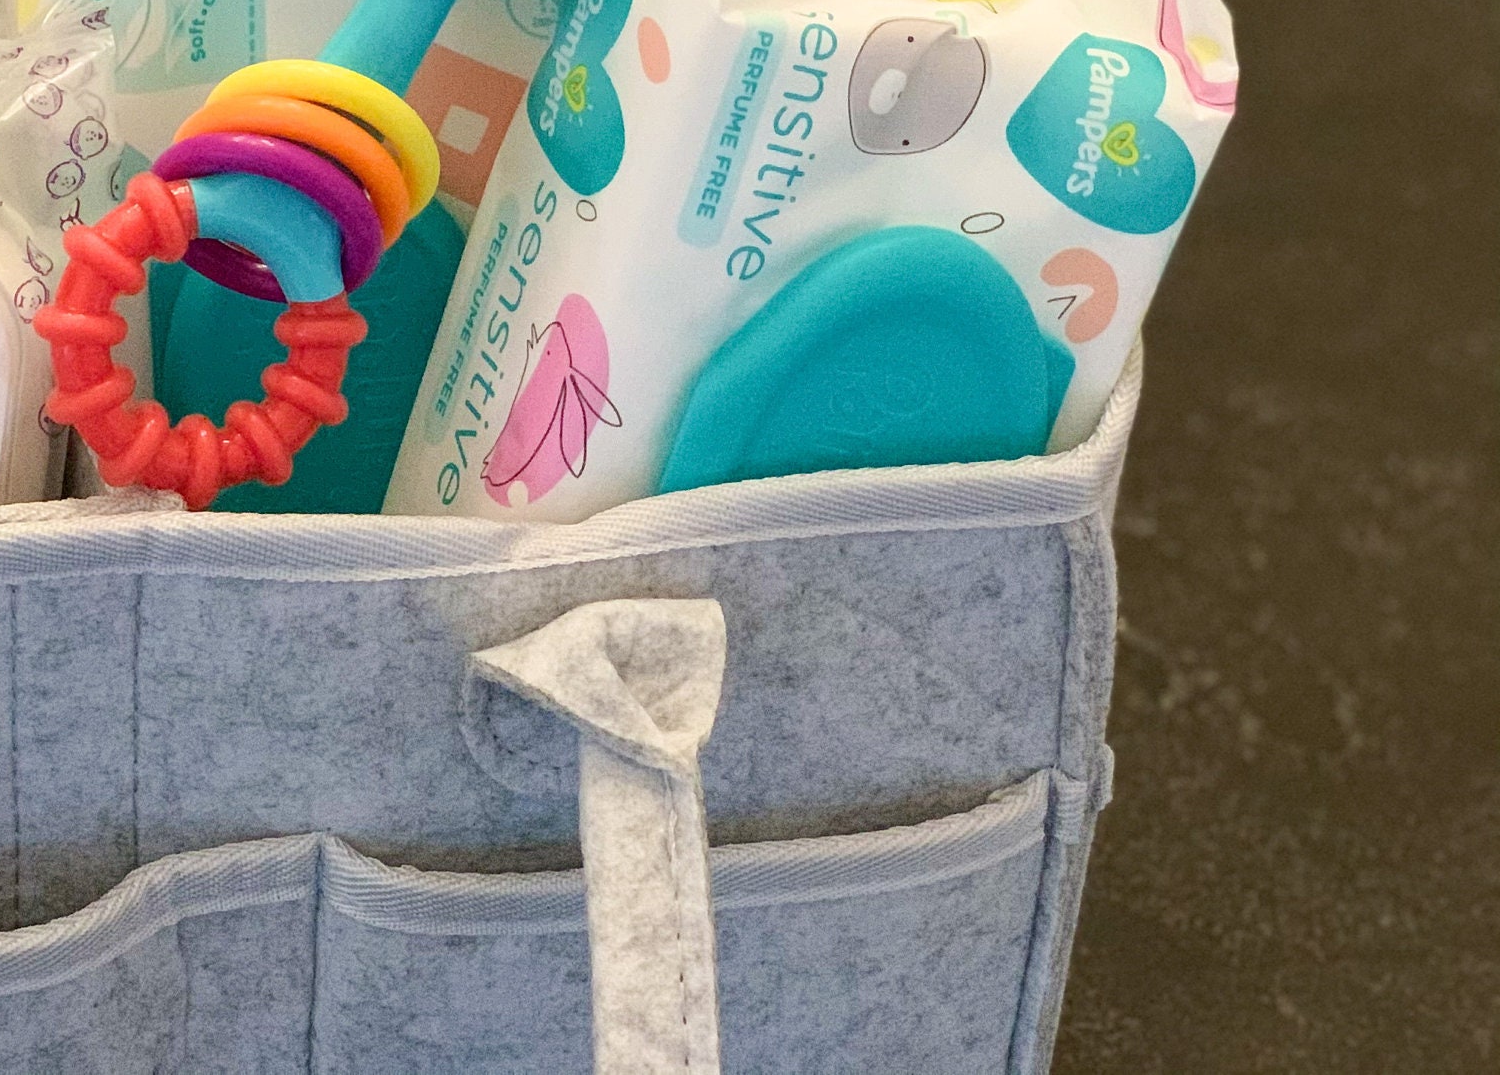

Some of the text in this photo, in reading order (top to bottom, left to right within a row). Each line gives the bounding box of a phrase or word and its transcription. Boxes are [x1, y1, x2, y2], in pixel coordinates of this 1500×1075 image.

[696, 29, 774, 220] PERFUME FREE
[726, 12, 838, 281] ensitive
[1066, 47, 1131, 198] Pampers
[435, 221, 509, 417] PERFUME FREE
[437, 180, 558, 507] sensitive
